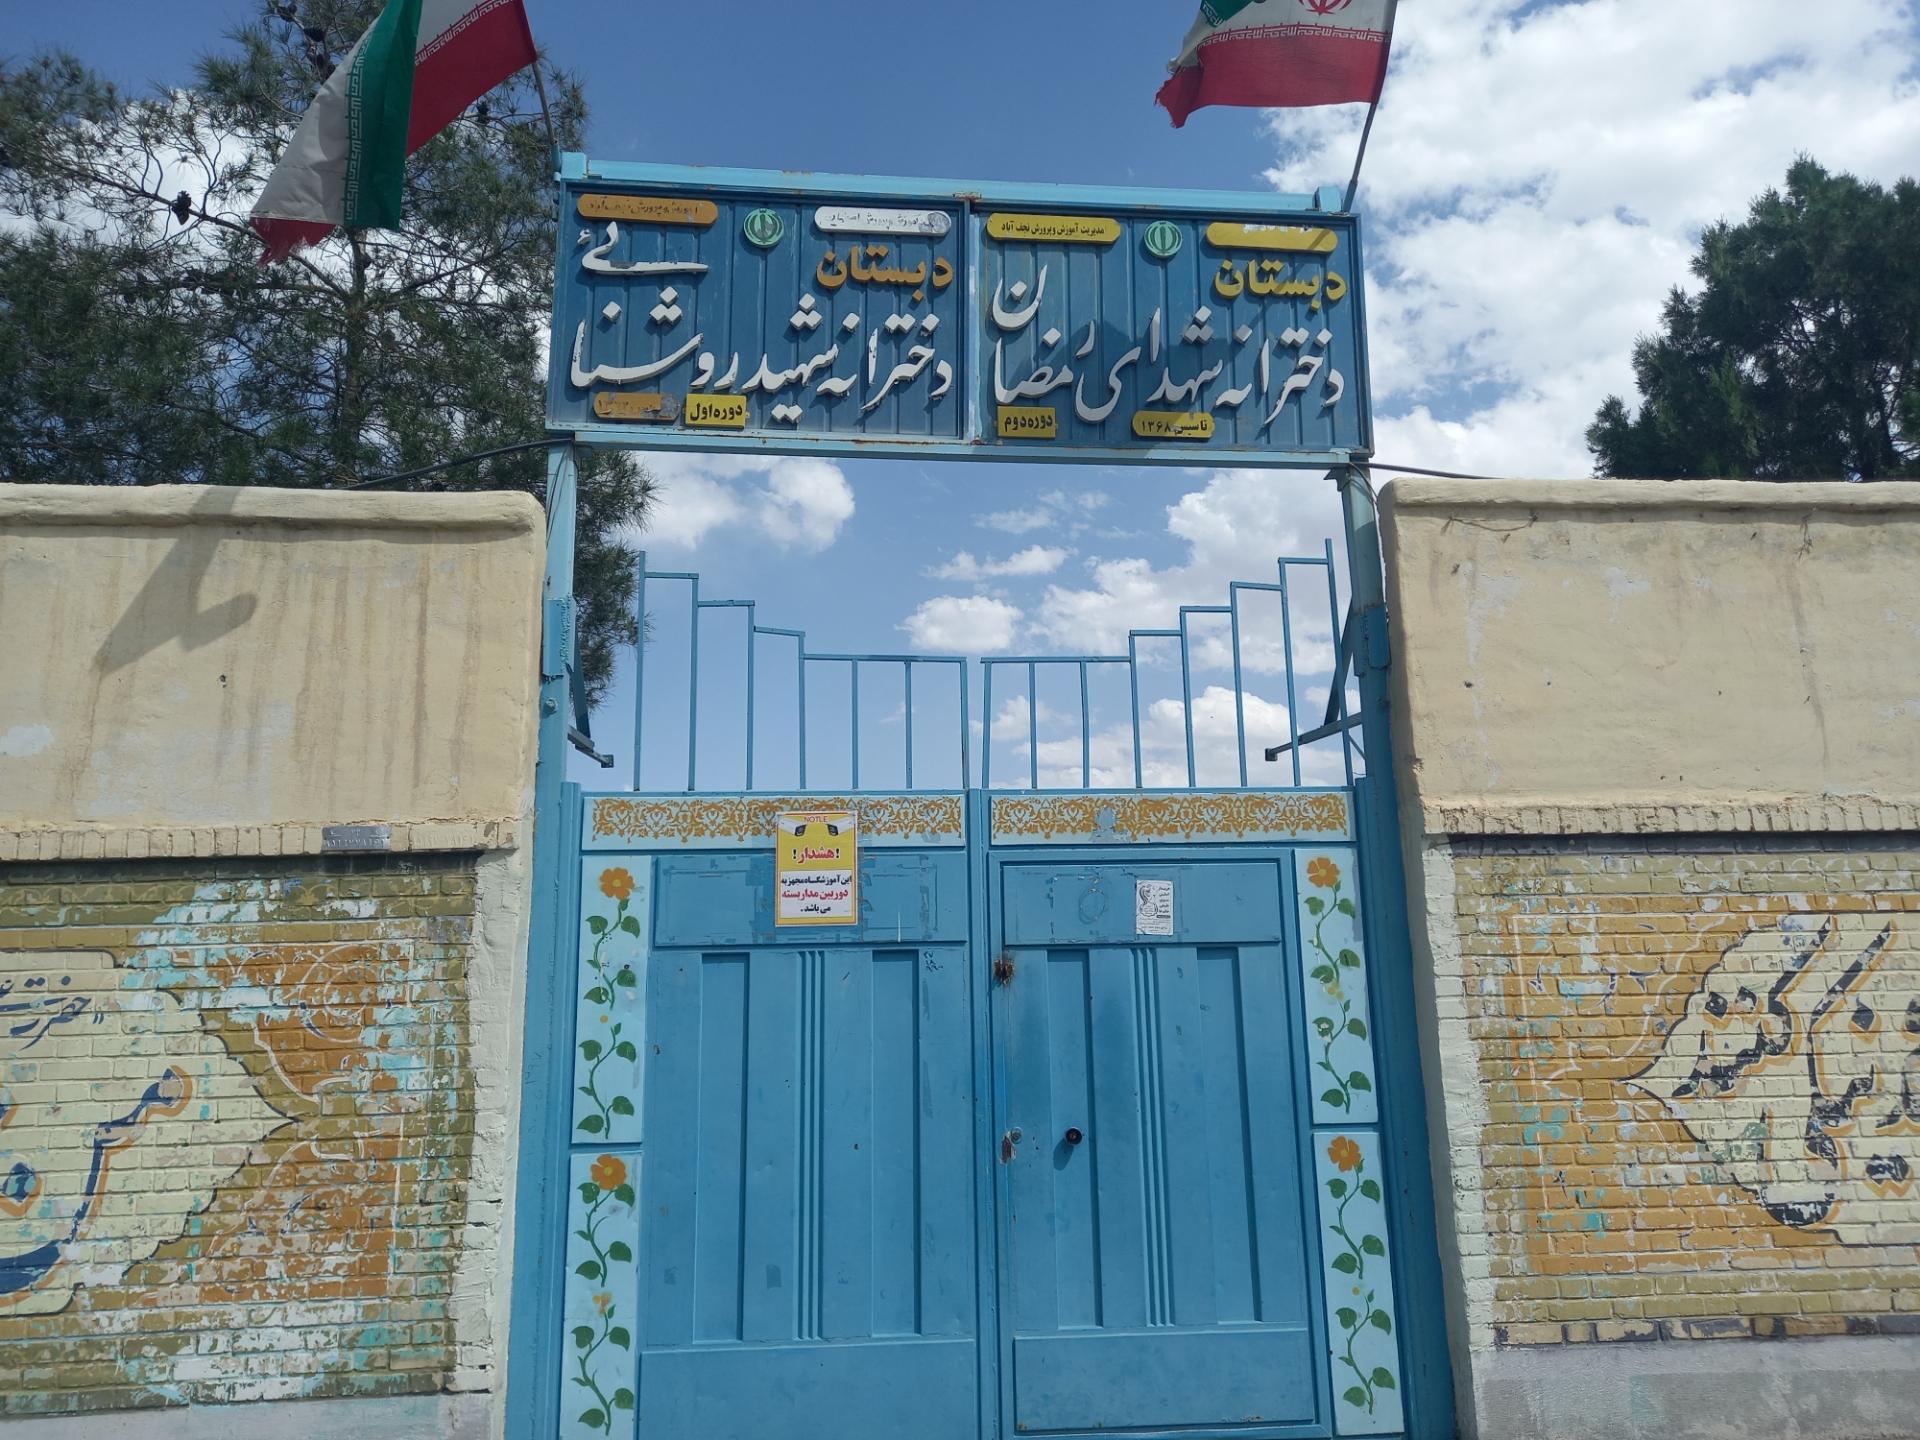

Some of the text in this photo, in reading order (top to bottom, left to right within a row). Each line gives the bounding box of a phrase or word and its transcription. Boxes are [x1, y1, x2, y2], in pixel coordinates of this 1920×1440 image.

[1056, 223, 1079, 236] آموزش
[1080, 225, 1104, 236] مدیریت
[816, 245, 953, 302] دبستان
[1214, 258, 1347, 312] دبستان
[741, 293, 840, 424] شهید
[816, 312, 953, 414] دخترانه
[1214, 324, 1345, 427] دخترانه
[820, 905, 832, 914] می
